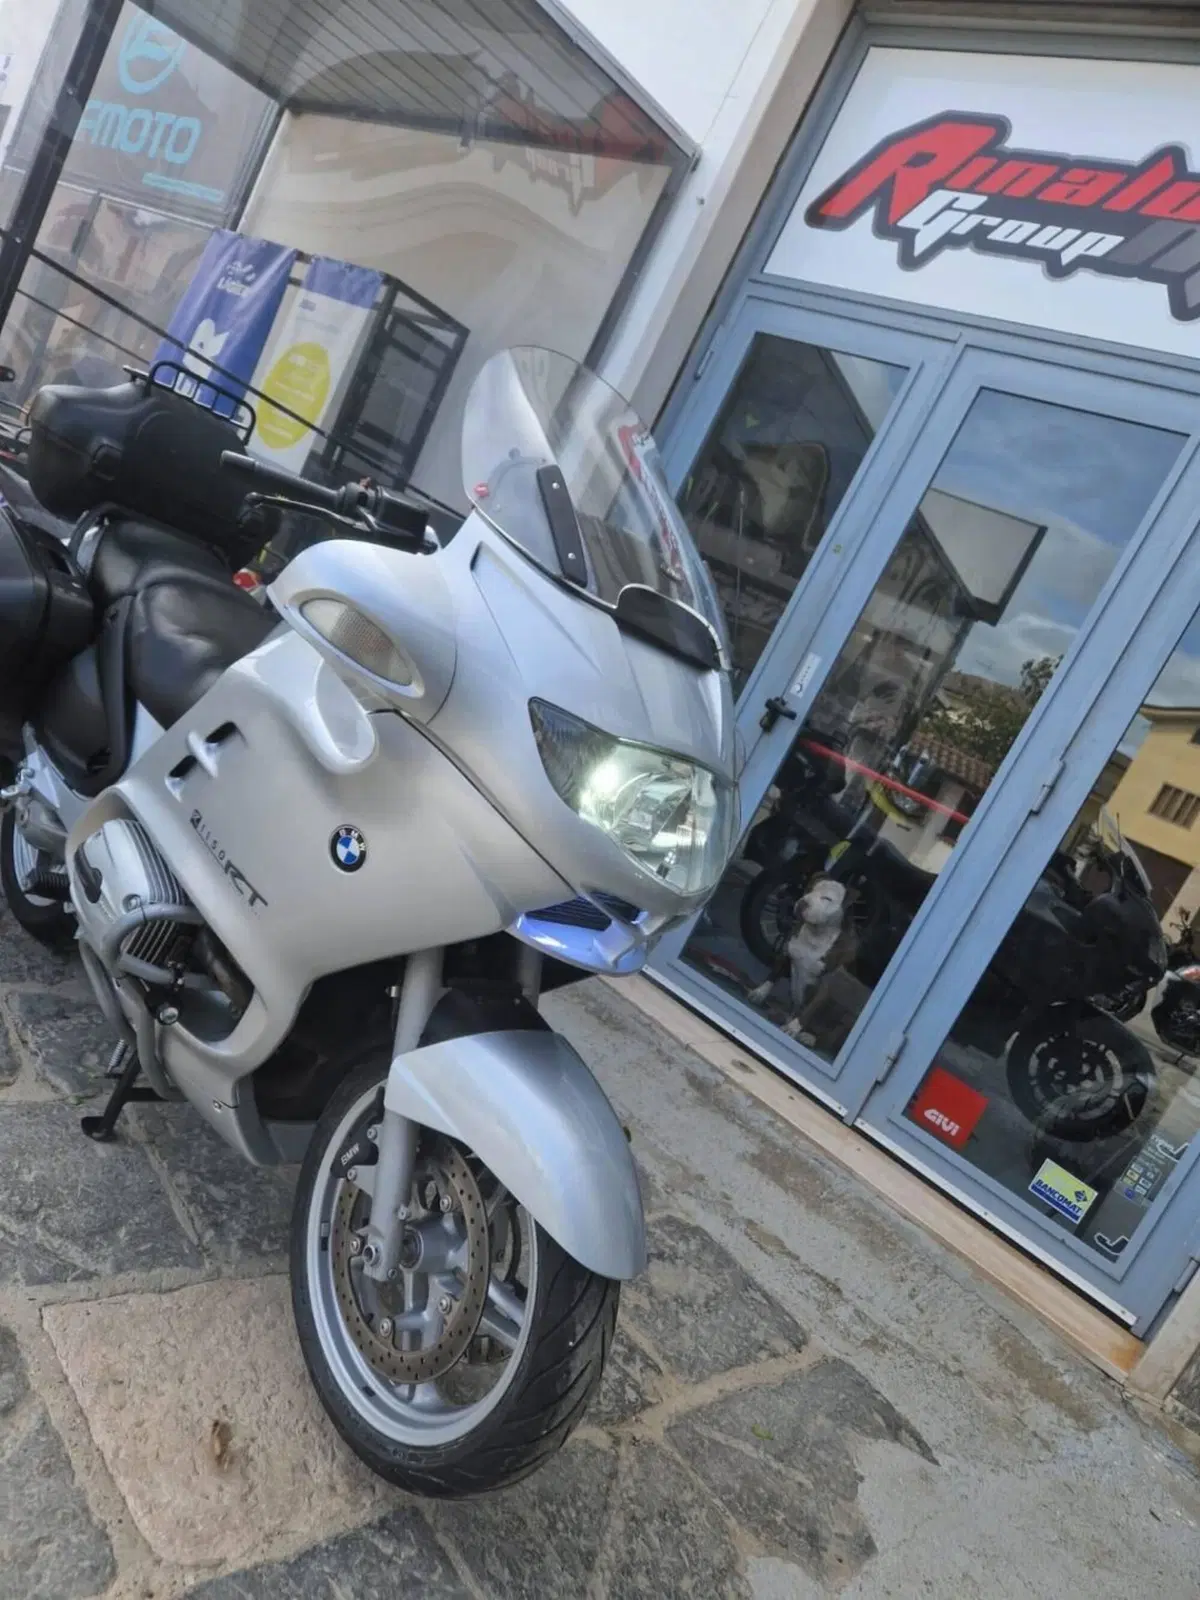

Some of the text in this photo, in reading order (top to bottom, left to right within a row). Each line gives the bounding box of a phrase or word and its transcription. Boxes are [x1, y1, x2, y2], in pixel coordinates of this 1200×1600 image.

[897, 189, 1125, 267] Group
[923, 1108, 960, 1136] GIVI
[341, 1142, 360, 1166] BMW
[1035, 1179, 1082, 1215] BANCOMAT
